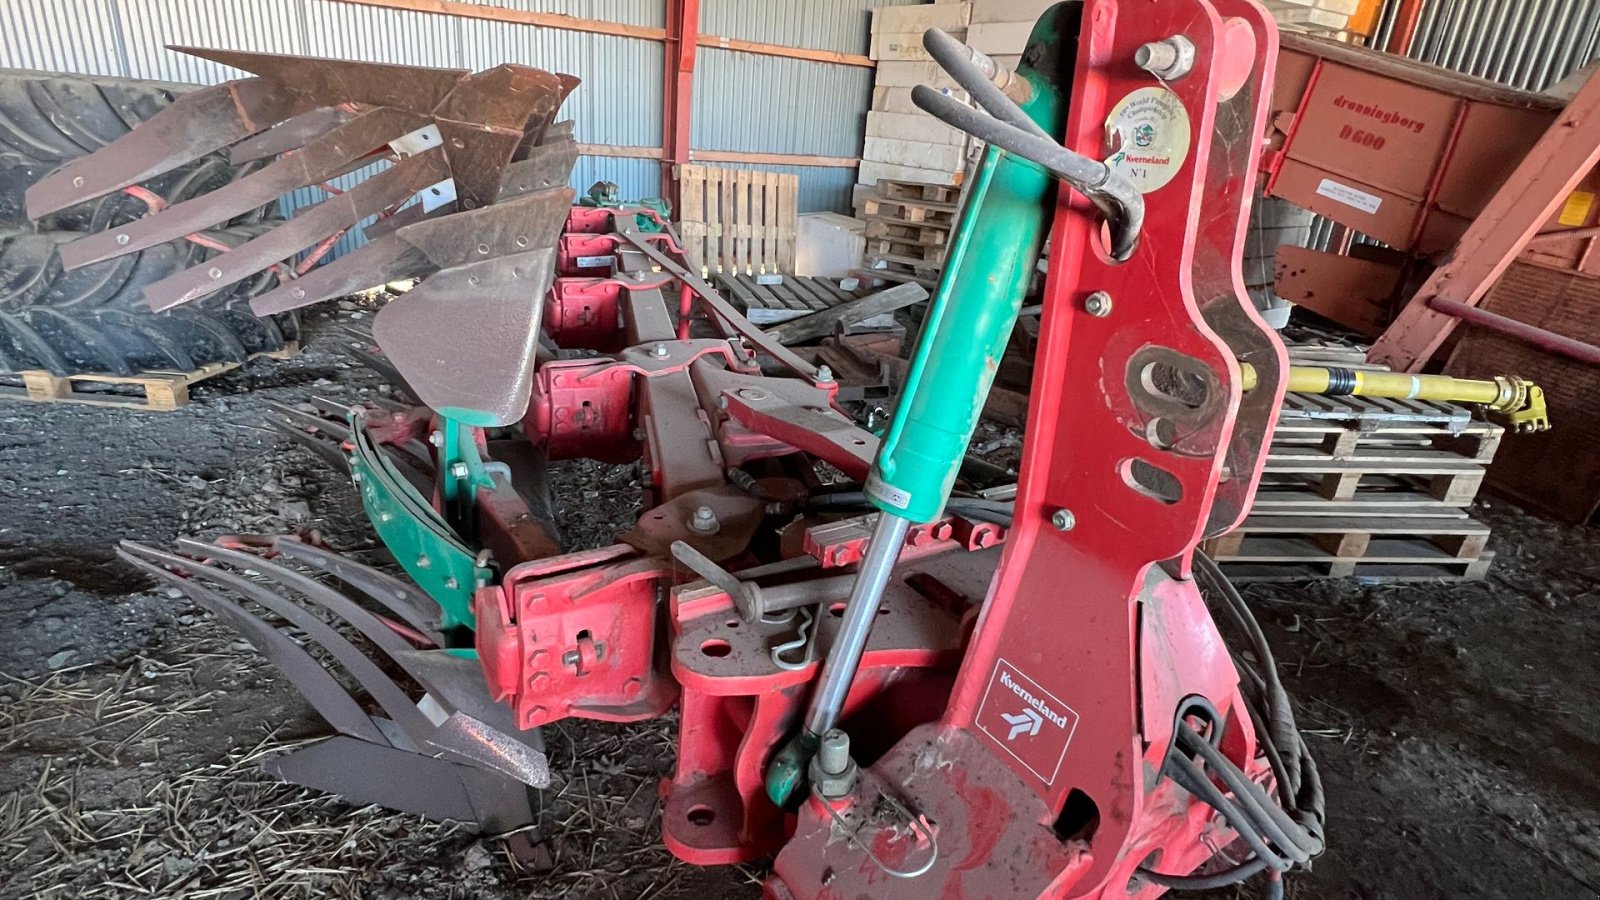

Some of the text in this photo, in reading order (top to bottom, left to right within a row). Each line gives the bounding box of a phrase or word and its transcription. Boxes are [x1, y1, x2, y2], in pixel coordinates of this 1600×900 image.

[1129, 96, 1150, 108] World
[1127, 106, 1168, 120] Championship
[1333, 94, 1425, 133] dronningborg
[1339, 124, 1386, 150] D600
[1125, 154, 1170, 165] Kverneland
[999, 670, 1068, 729] Kverneland
